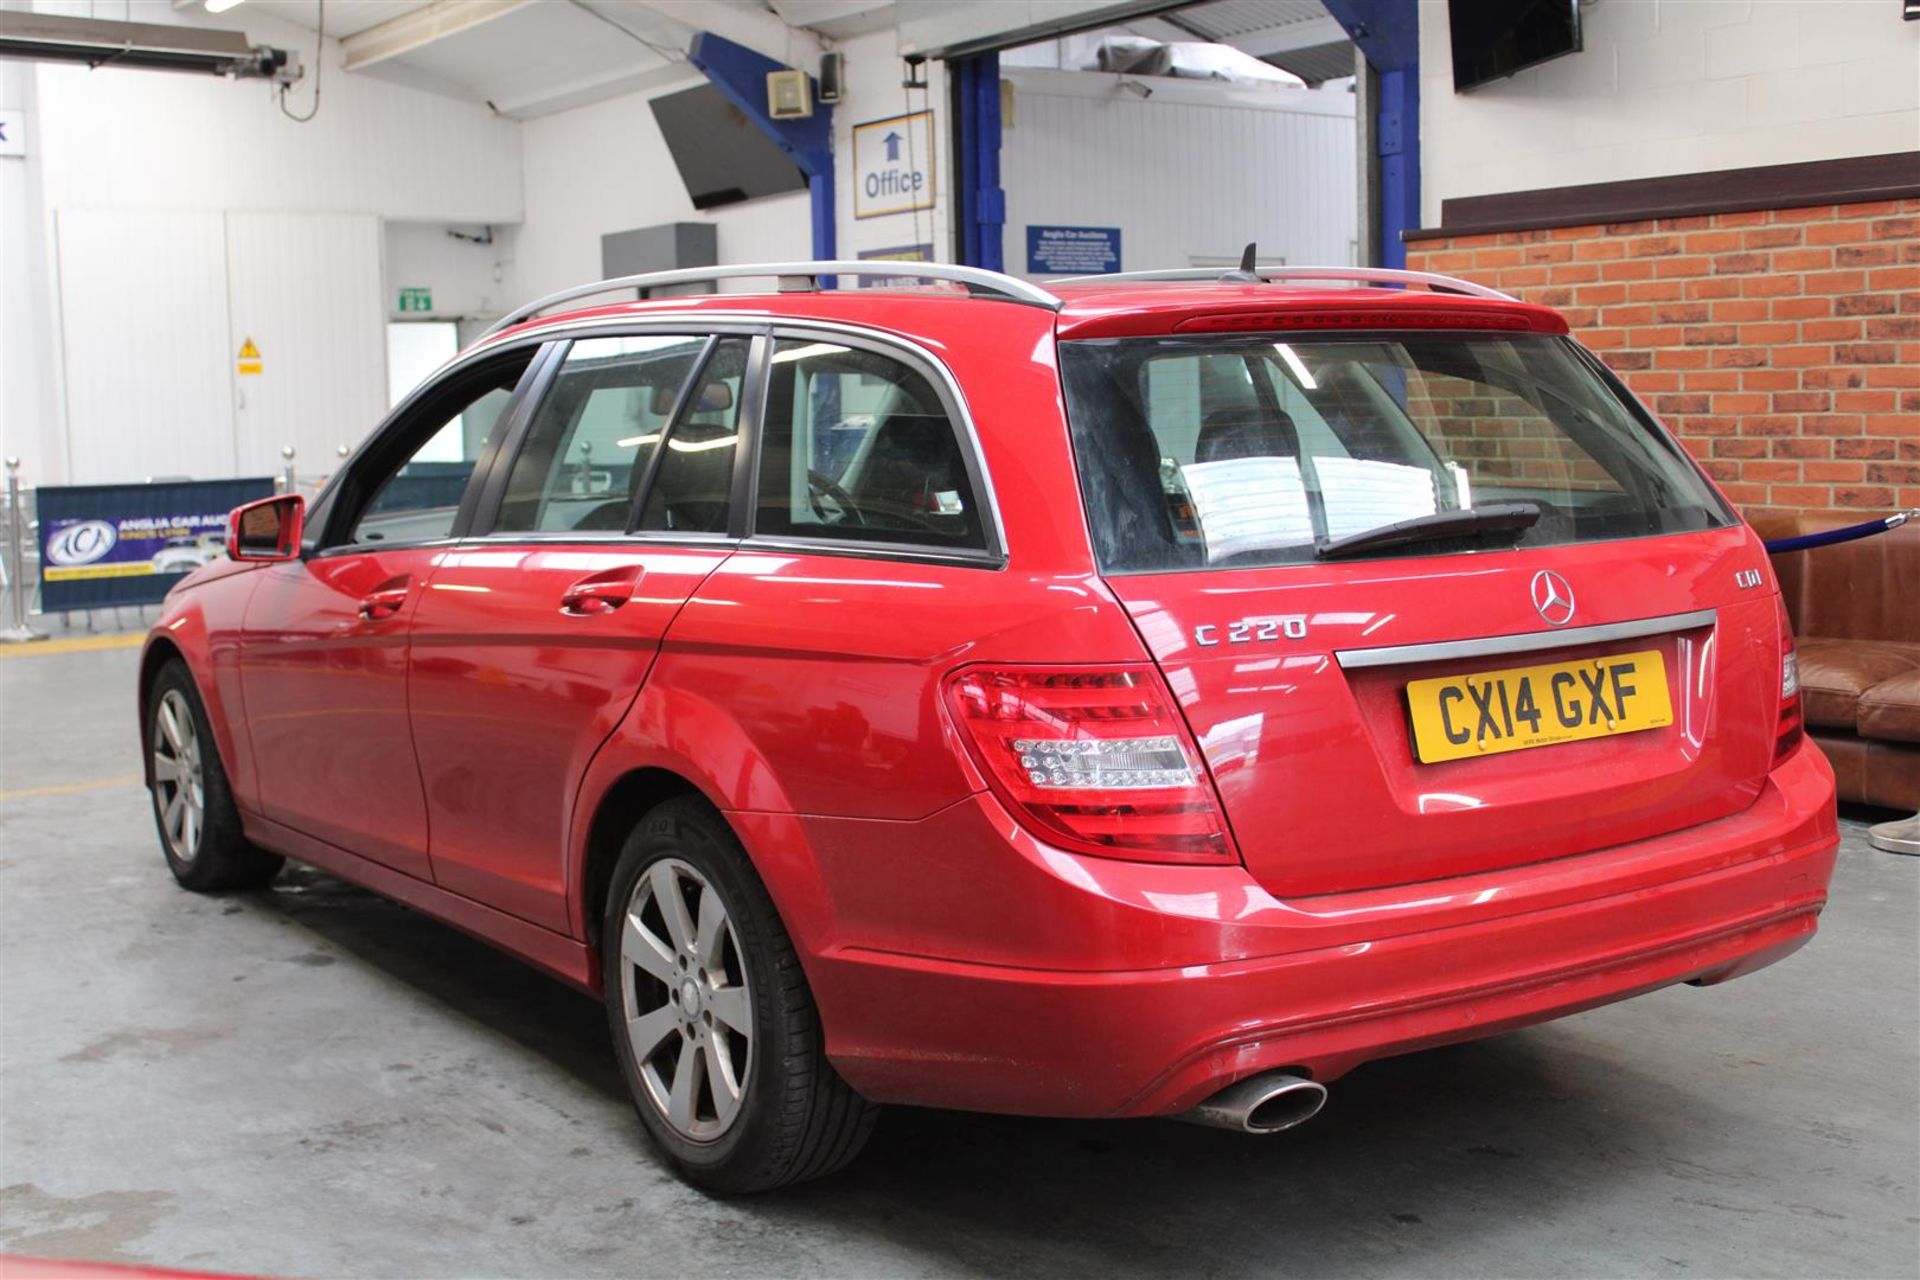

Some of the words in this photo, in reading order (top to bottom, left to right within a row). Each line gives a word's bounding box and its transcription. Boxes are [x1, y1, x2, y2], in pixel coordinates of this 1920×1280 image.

[865, 169, 922, 198] Office
[118, 517, 168, 531] ANGLIA
[170, 515, 198, 529] CAR
[1735, 568, 1763, 589] CDI
[1195, 624, 1220, 647] C
[1228, 617, 1307, 645] 220
[1438, 676, 1542, 746] CX14
[1551, 662, 1637, 729] GXF
